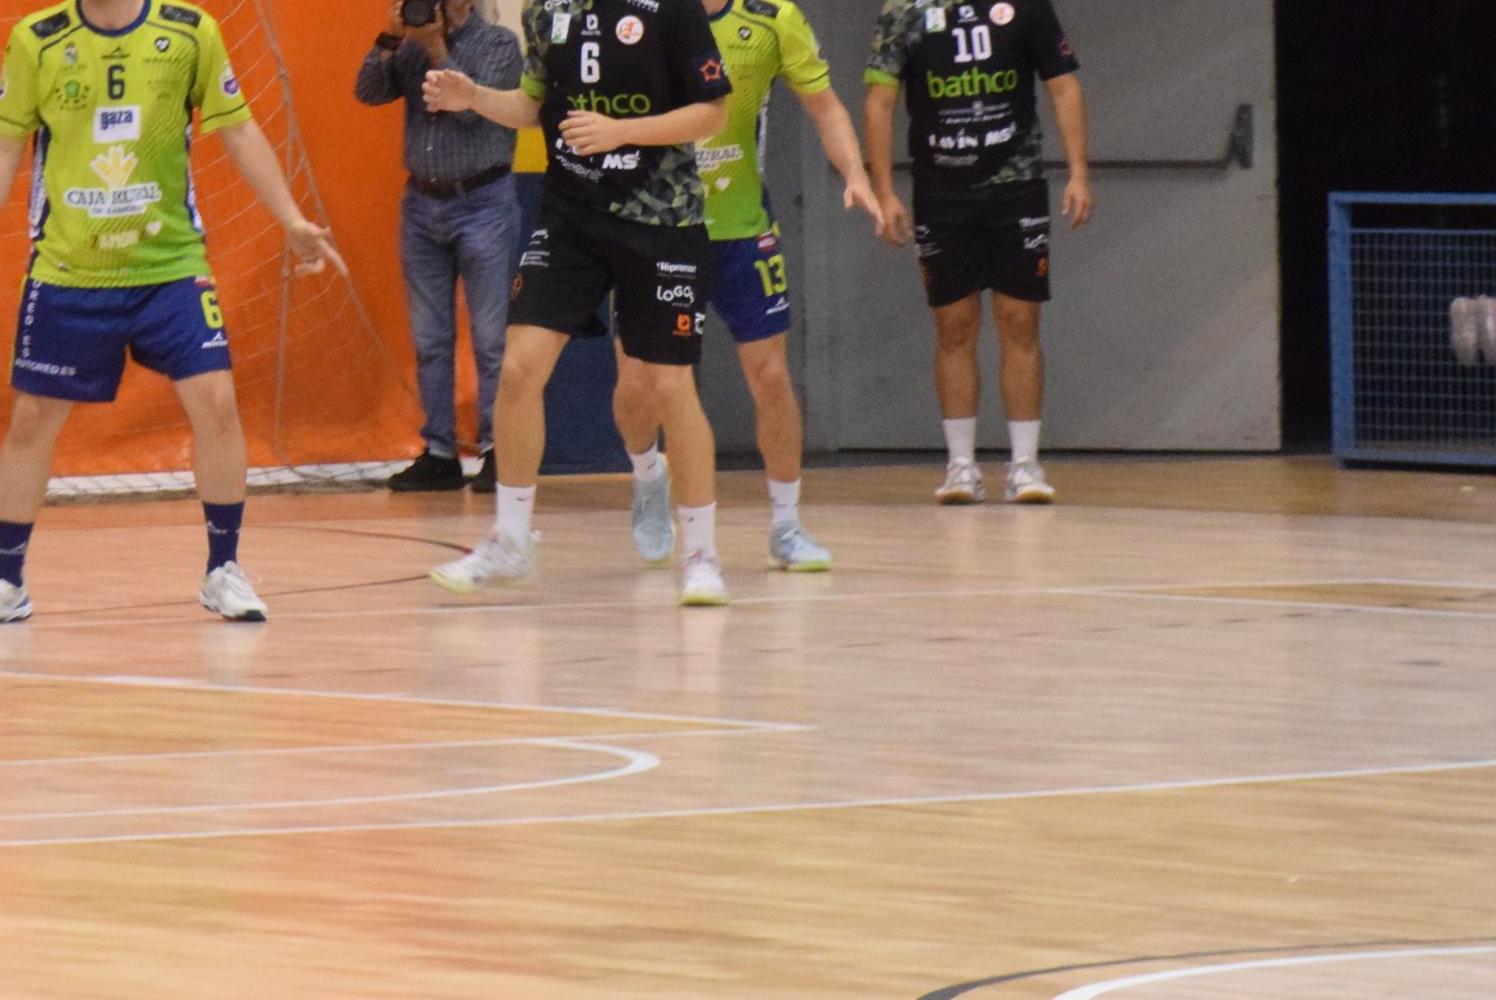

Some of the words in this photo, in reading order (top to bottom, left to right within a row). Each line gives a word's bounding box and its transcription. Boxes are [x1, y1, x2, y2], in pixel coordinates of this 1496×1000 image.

[952, 25, 992, 63] 10
[580, 41, 600, 84] 6
[107, 65, 126, 100] 6
[926, 67, 1017, 98] bathco
[568, 90, 651, 114] thco
[100, 110, 134, 130] gaza
[67, 189, 106, 206] CAJA
[754, 255, 788, 297] 13
[201, 291, 224, 329] 6
